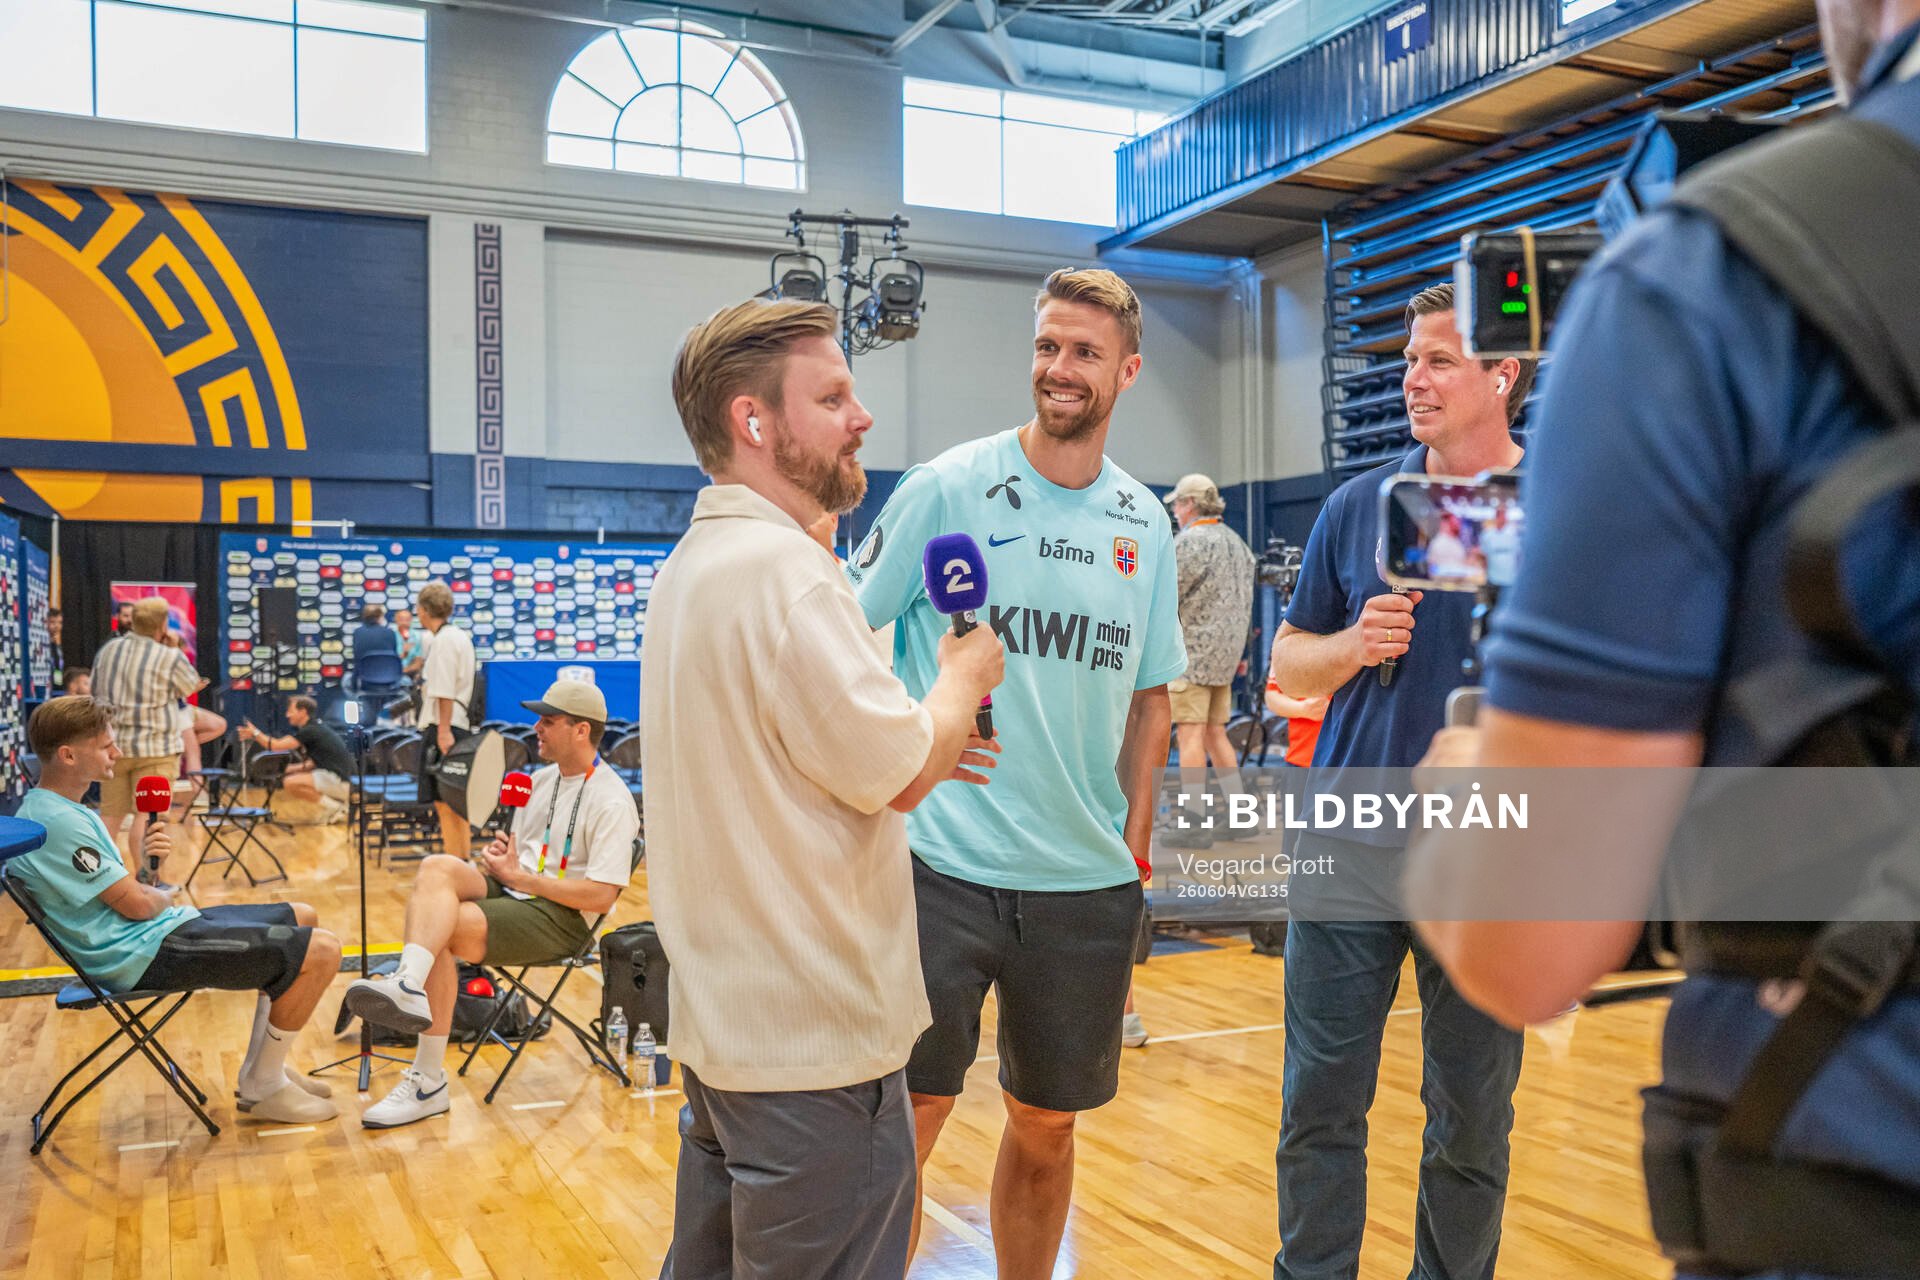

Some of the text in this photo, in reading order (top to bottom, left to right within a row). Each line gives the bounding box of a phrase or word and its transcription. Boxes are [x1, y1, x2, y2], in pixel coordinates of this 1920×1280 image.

[1105, 509, 1149, 528] Norsk Tipping
[943, 559, 974, 593] 2
[990, 605, 1131, 662] KIWI mini
[1090, 645, 1123, 671] pris
